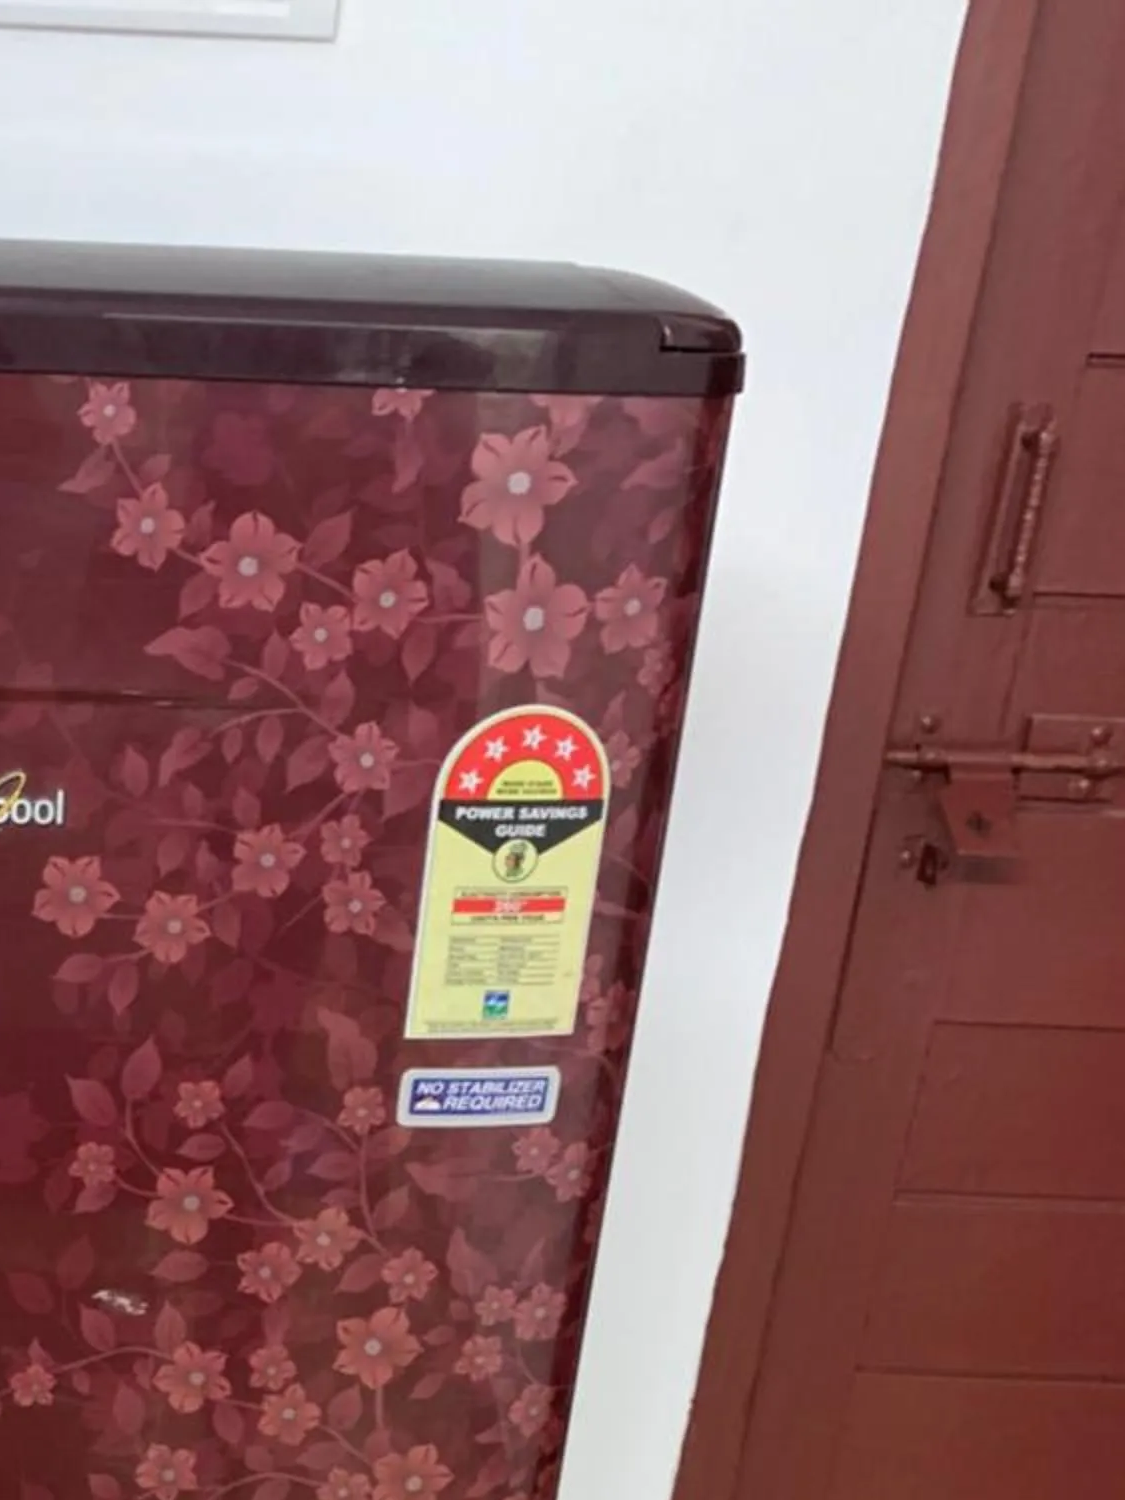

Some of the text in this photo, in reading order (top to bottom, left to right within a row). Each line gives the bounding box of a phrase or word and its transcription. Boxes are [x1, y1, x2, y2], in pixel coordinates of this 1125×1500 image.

[455, 804, 589, 820] POWER SAVINGS
[495, 823, 547, 838] GUIDE
[415, 1078, 545, 1096] NO STABILIZER
[442, 1094, 542, 1112] REQUIRED
